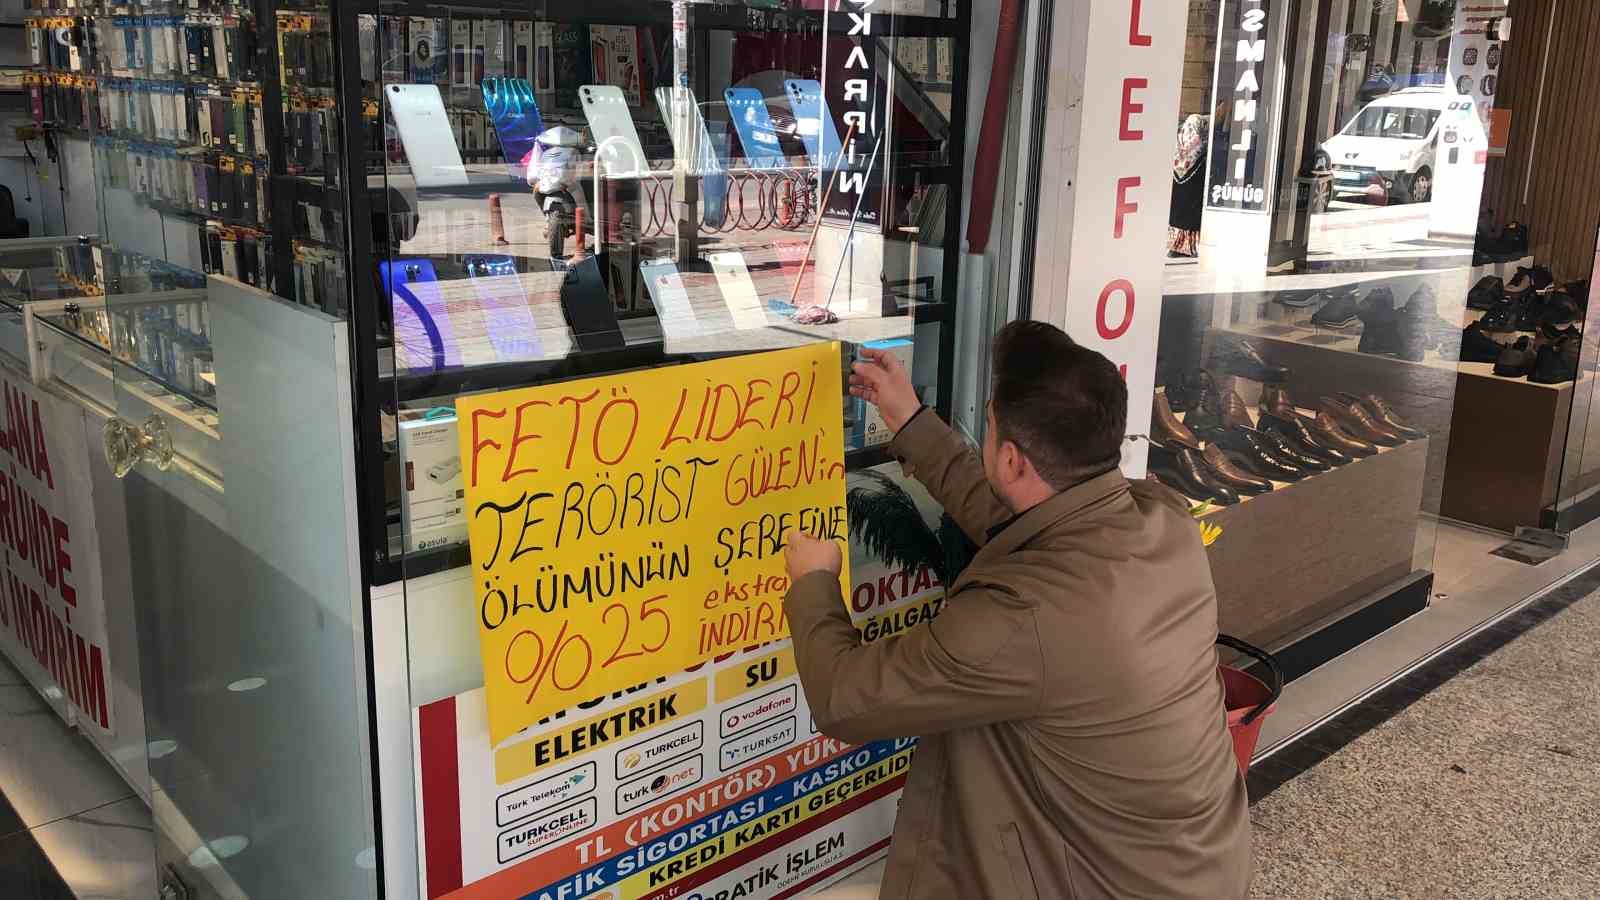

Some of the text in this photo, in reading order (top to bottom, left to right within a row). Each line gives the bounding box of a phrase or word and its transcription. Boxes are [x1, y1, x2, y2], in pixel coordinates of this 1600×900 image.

[1096, 0, 1152, 383] LEFO
[471, 361, 818, 487] FETÖ LİDERİ
[475, 458, 719, 570] TERÖRİST
[481, 542, 690, 629] ÖLÜMÜNÜN
[704, 574, 788, 609] ekstra
[6, 550, 109, 729] İNDİRİM
[857, 597, 944, 642] ĞALGAZ
[746, 657, 777, 688] SU
[742, 696, 791, 720] vodafone
[645, 732, 698, 759] TURKCELL
[531, 783, 570, 803] Telekom
[576, 835, 611, 864] TL
[624, 764, 777, 846] (KONTÖR)
[616, 796, 765, 877] SİGORTASI
[793, 750, 870, 797] KASKO
[505, 809, 587, 848] TURKCELL
[650, 837, 725, 888] KREDİ
[735, 805, 800, 848] KARTI
[786, 832, 844, 874] İŞLEM
